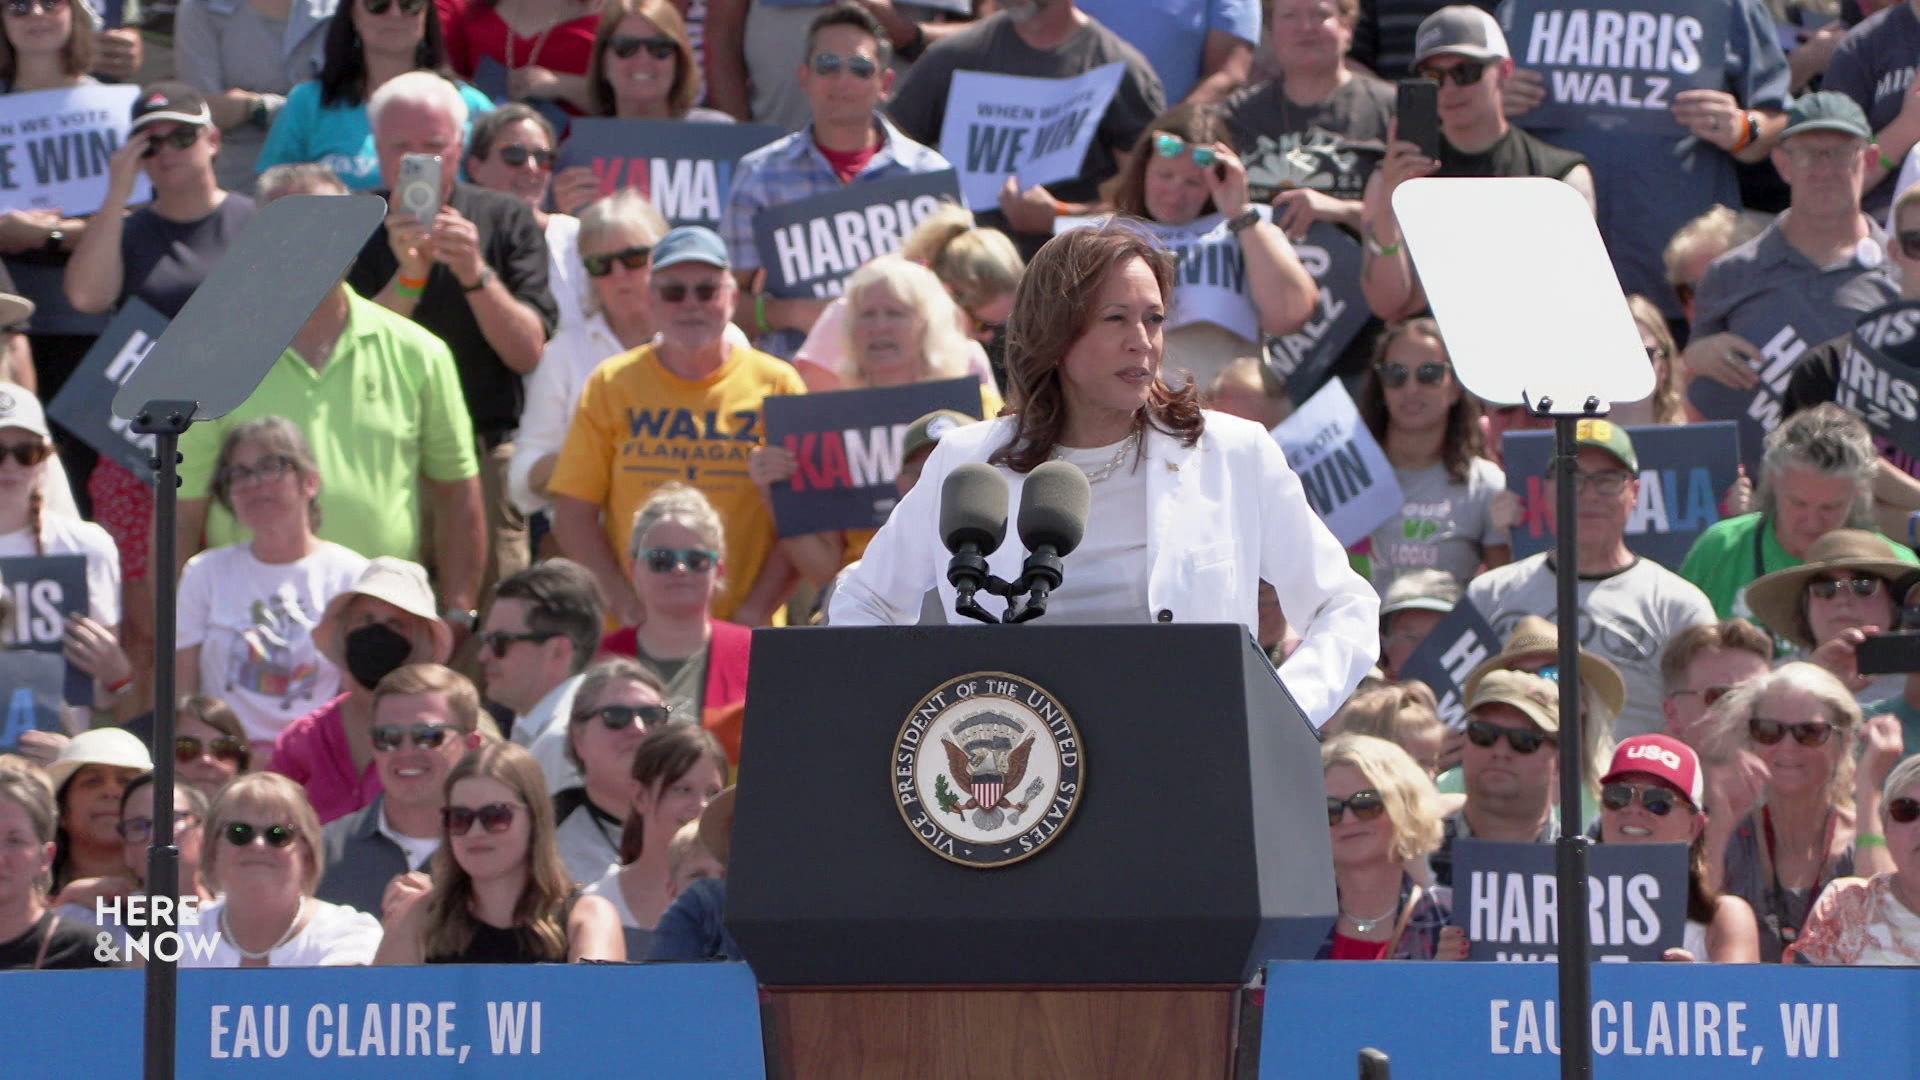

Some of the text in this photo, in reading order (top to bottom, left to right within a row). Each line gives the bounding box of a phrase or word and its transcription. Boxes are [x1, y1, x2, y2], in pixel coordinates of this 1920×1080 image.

[1526, 9, 1703, 74] HARRIS
[977, 102, 1035, 120] WHEN
[1552, 70, 1671, 110] WALZ
[26, 127, 118, 184] WIN
[965, 106, 1091, 174] WE WIN
[626, 407, 760, 443] WALZ
[1301, 439, 1374, 516] WIN
[897, 679, 1078, 856] VICE PRESIDENT OF THE UNITED STATES
[1470, 871, 1661, 946] HARRIS
[210, 1001, 542, 1064] EAU CLAIRE, WI
[1490, 999, 1839, 1066] EAU CLAIRE, WI
